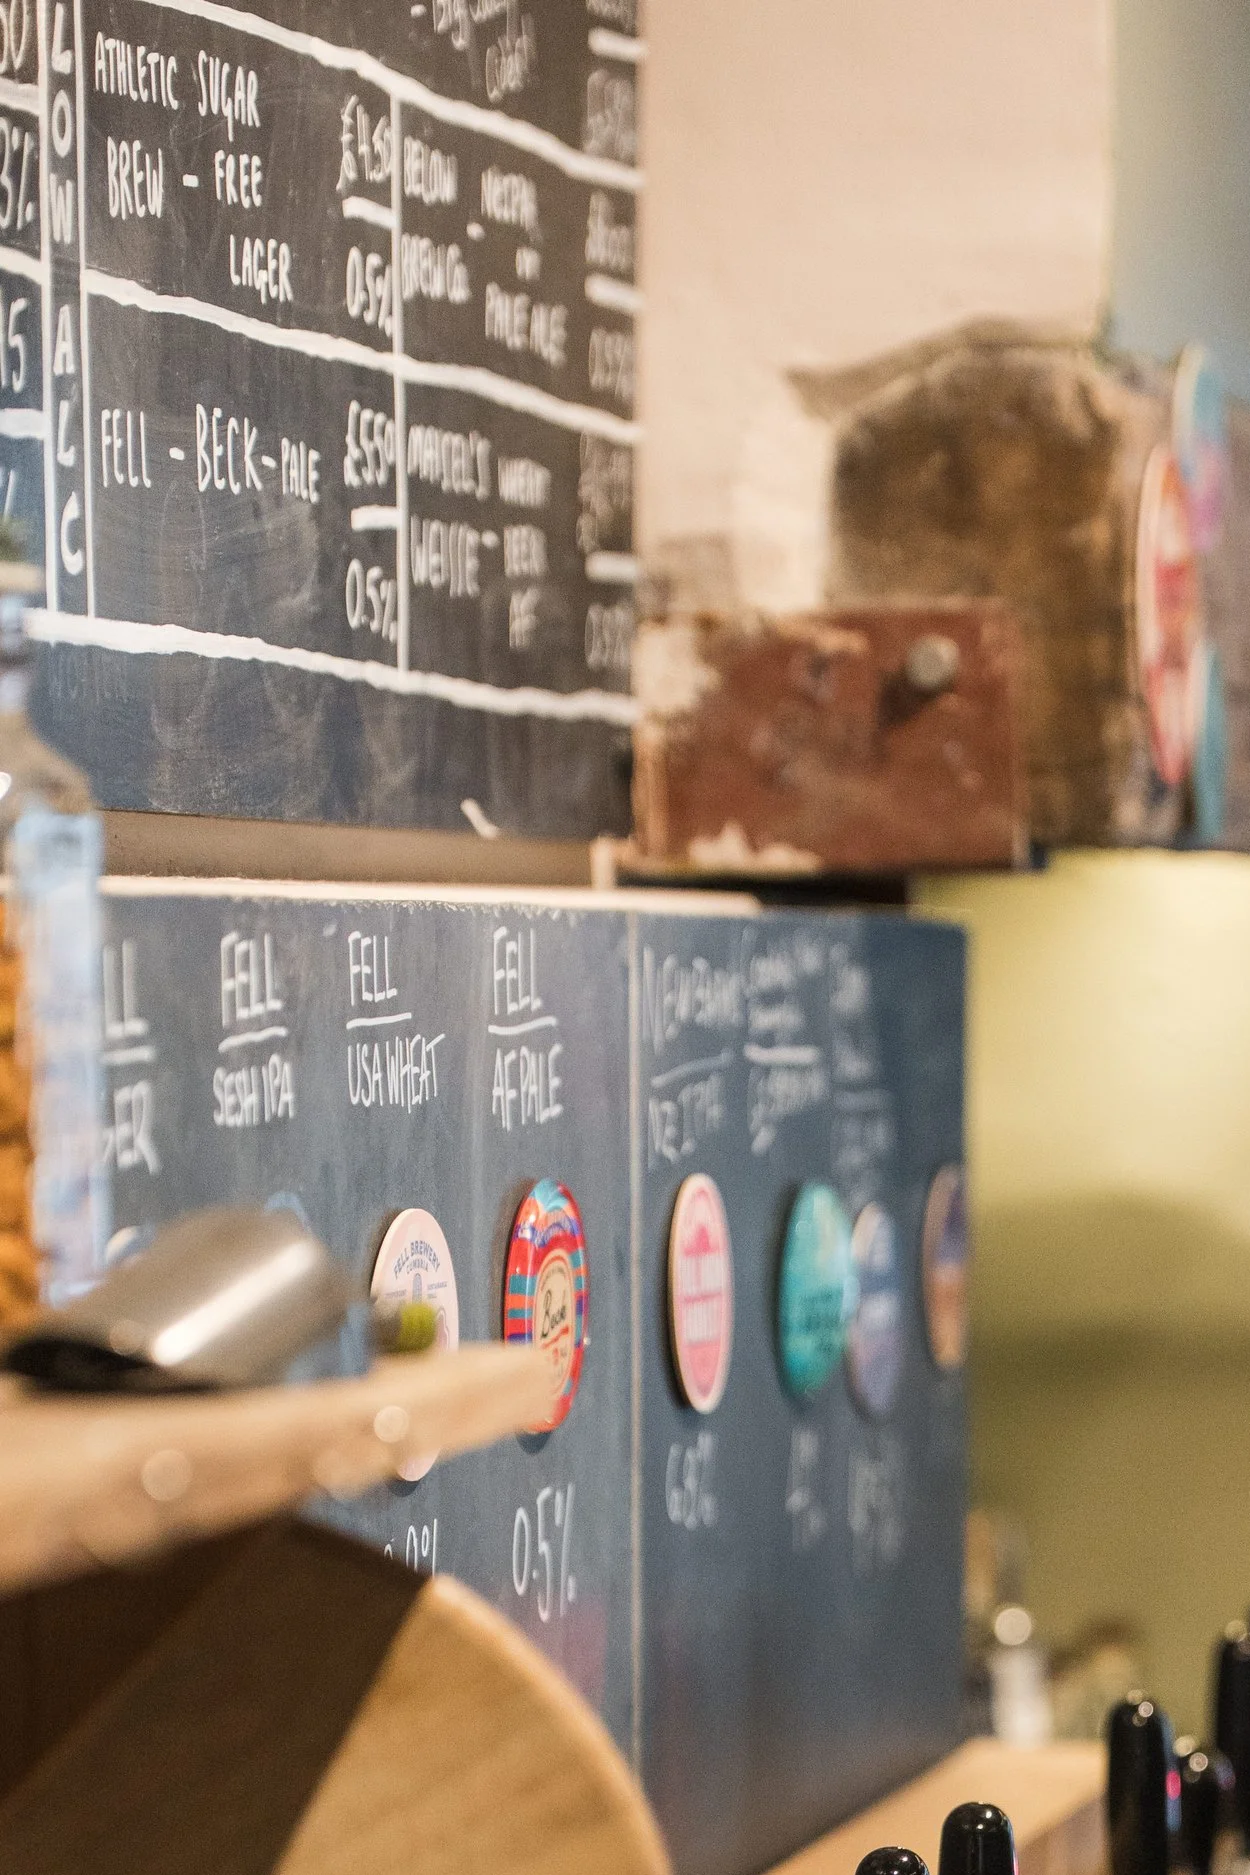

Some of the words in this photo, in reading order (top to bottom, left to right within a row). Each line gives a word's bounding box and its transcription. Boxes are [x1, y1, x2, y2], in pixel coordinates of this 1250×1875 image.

[94, 31, 179, 111] ATHLETIC
[197, 50, 261, 143] SUGAR
[107, 136, 165, 220] BREW
[214, 150, 264, 209] FREE
[228, 233, 295, 304] LAGER
[345, 245, 394, 338] 0.5%
[101, 408, 151, 488] FELL
[346, 558, 396, 643] 0.5%
[220, 931, 282, 1029] FELL
[348, 930, 397, 1006] FELL
[493, 925, 543, 1016] FELL
[348, 1042, 384, 1107] USA
[386, 1033, 446, 1114] WHEAT
[492, 1048, 517, 1131] AF
[520, 1043, 563, 1124] PALE
[393, 1248, 411, 1280] FELL
[410, 1240, 441, 1273] BREWERY
[512, 1484, 576, 1623] 0.5%
